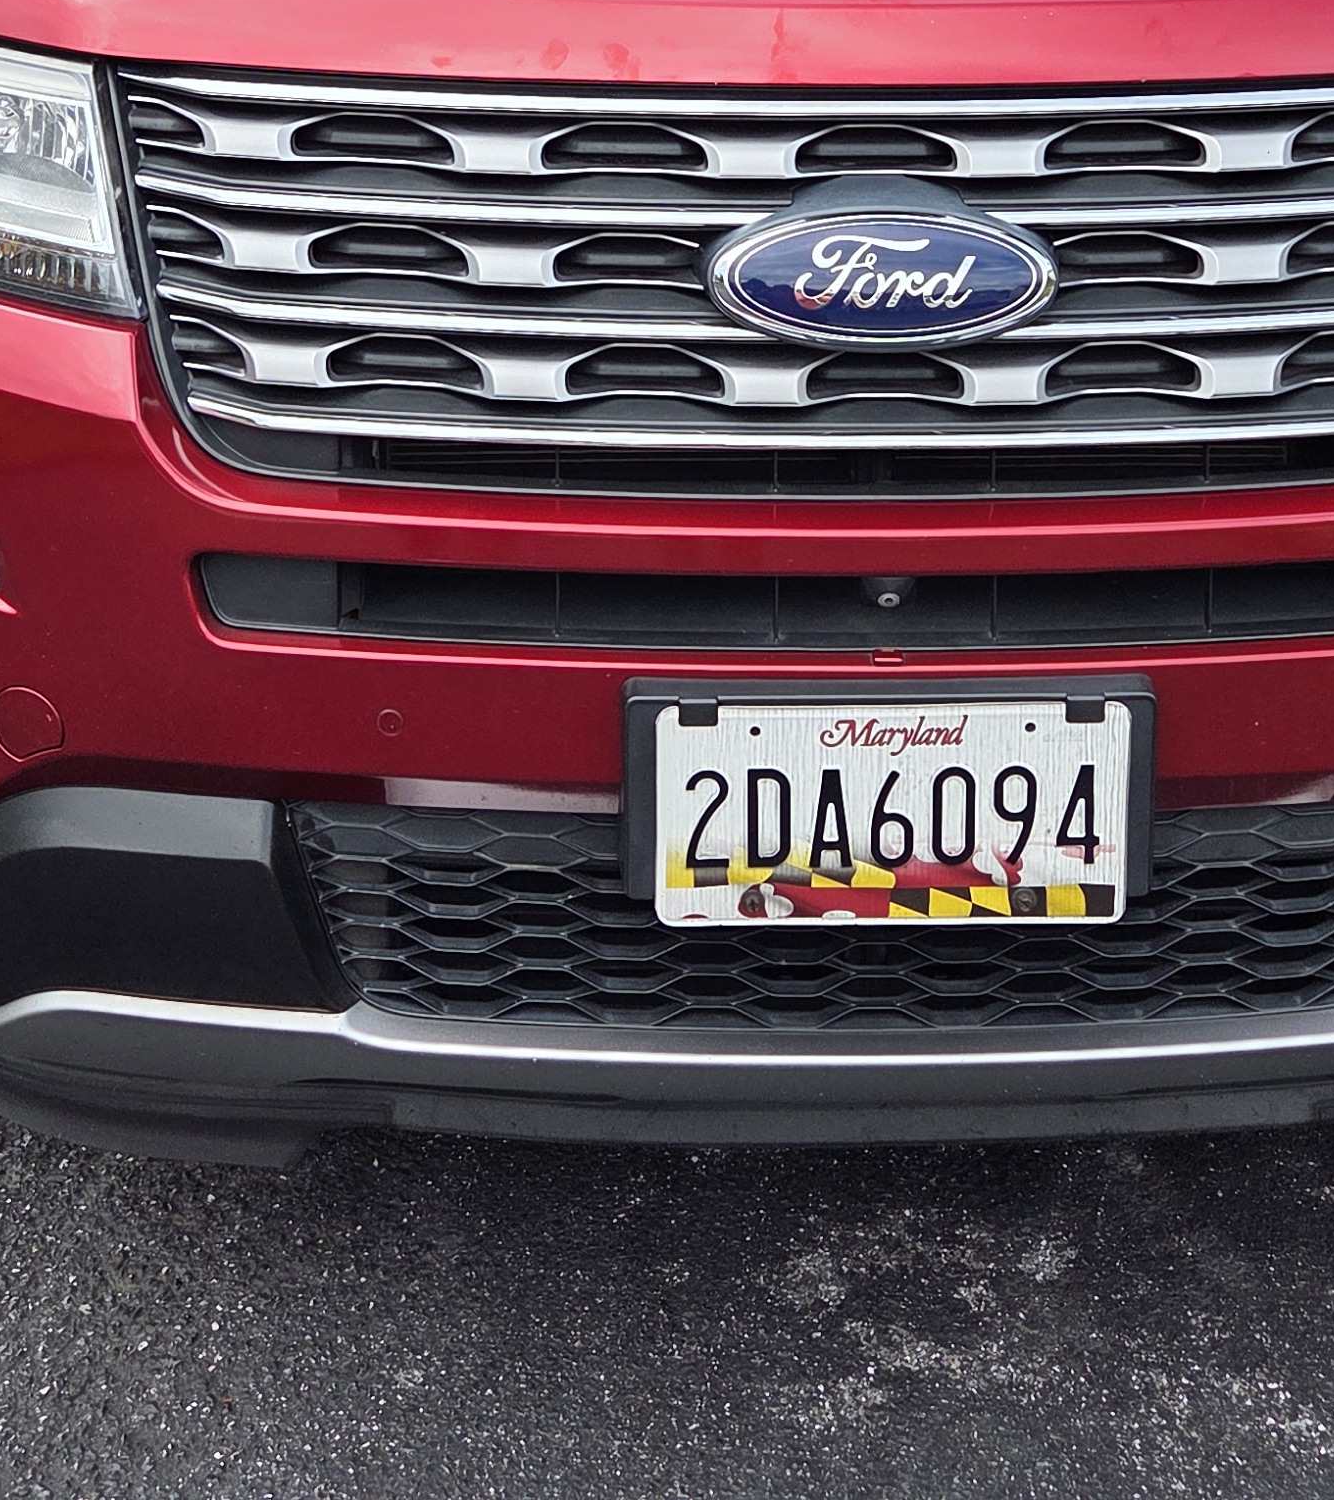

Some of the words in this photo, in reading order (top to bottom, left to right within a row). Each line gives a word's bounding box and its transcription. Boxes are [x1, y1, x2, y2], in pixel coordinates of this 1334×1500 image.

[794, 234, 976, 310] Ford
[819, 715, 969, 756] Maryland
[685, 764, 1100, 868] 2DA6094
